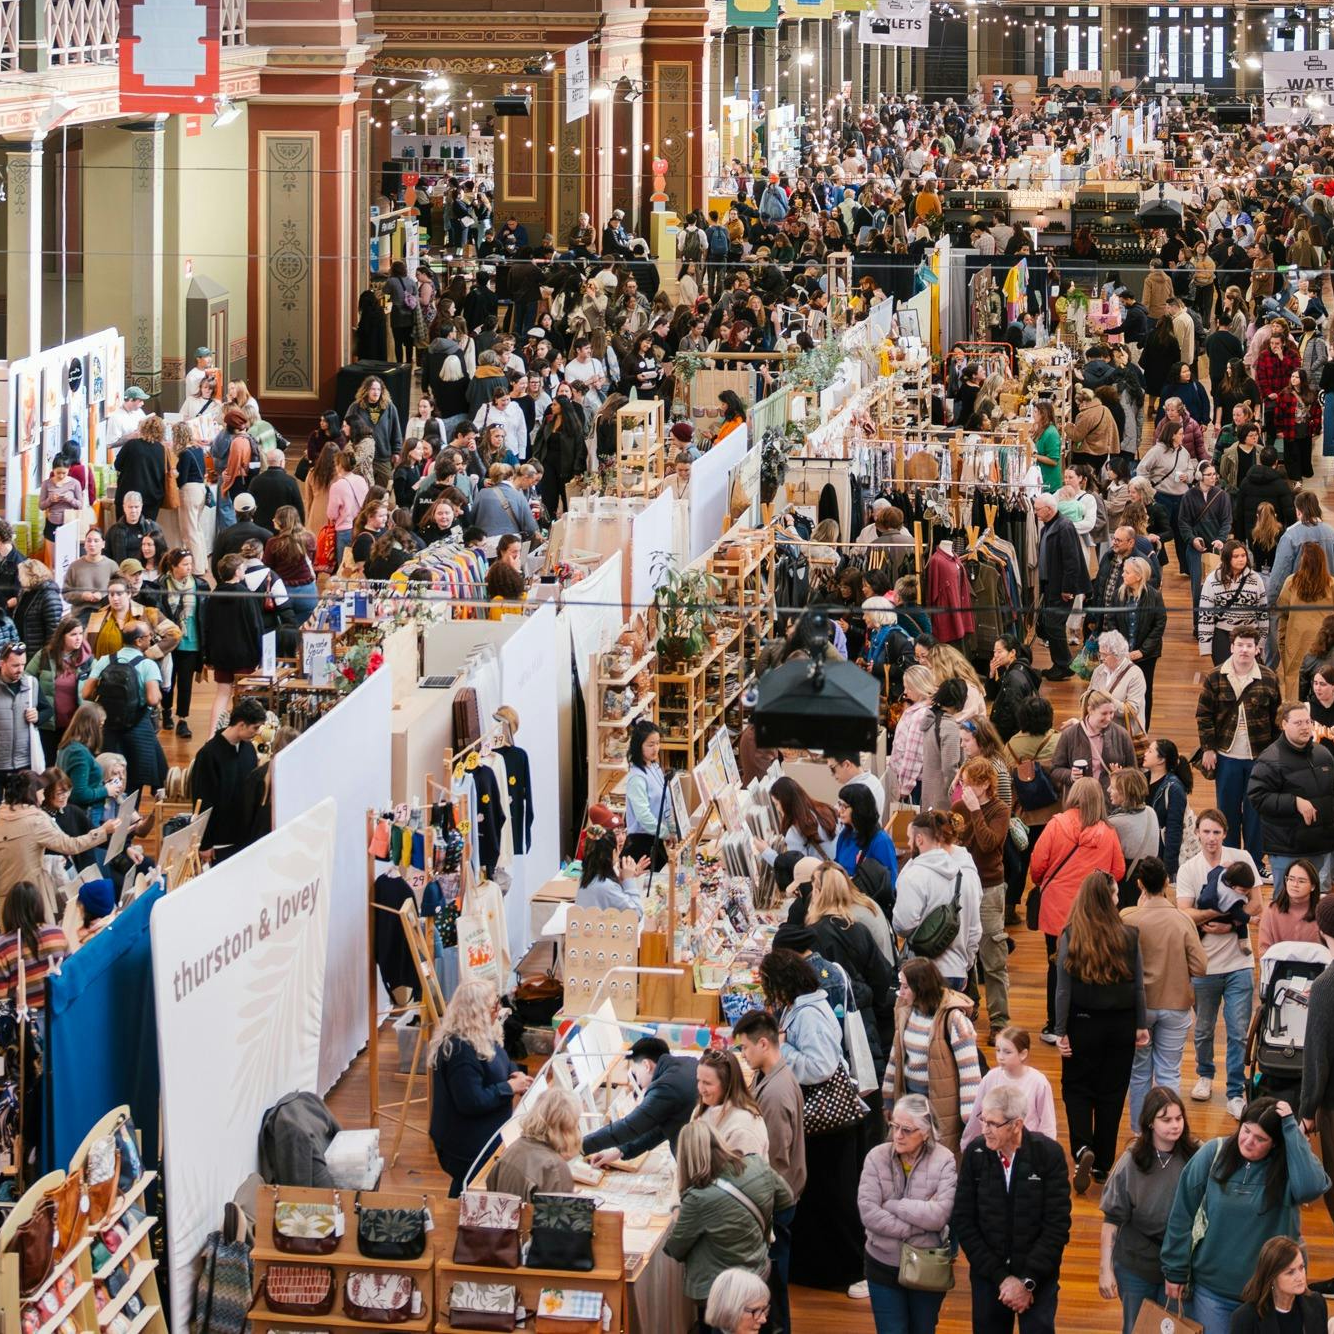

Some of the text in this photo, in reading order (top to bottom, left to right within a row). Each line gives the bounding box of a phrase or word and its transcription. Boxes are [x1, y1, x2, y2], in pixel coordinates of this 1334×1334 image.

[413, 875, 425, 887] 29
[173, 878, 320, 1002] thurston & lovey
